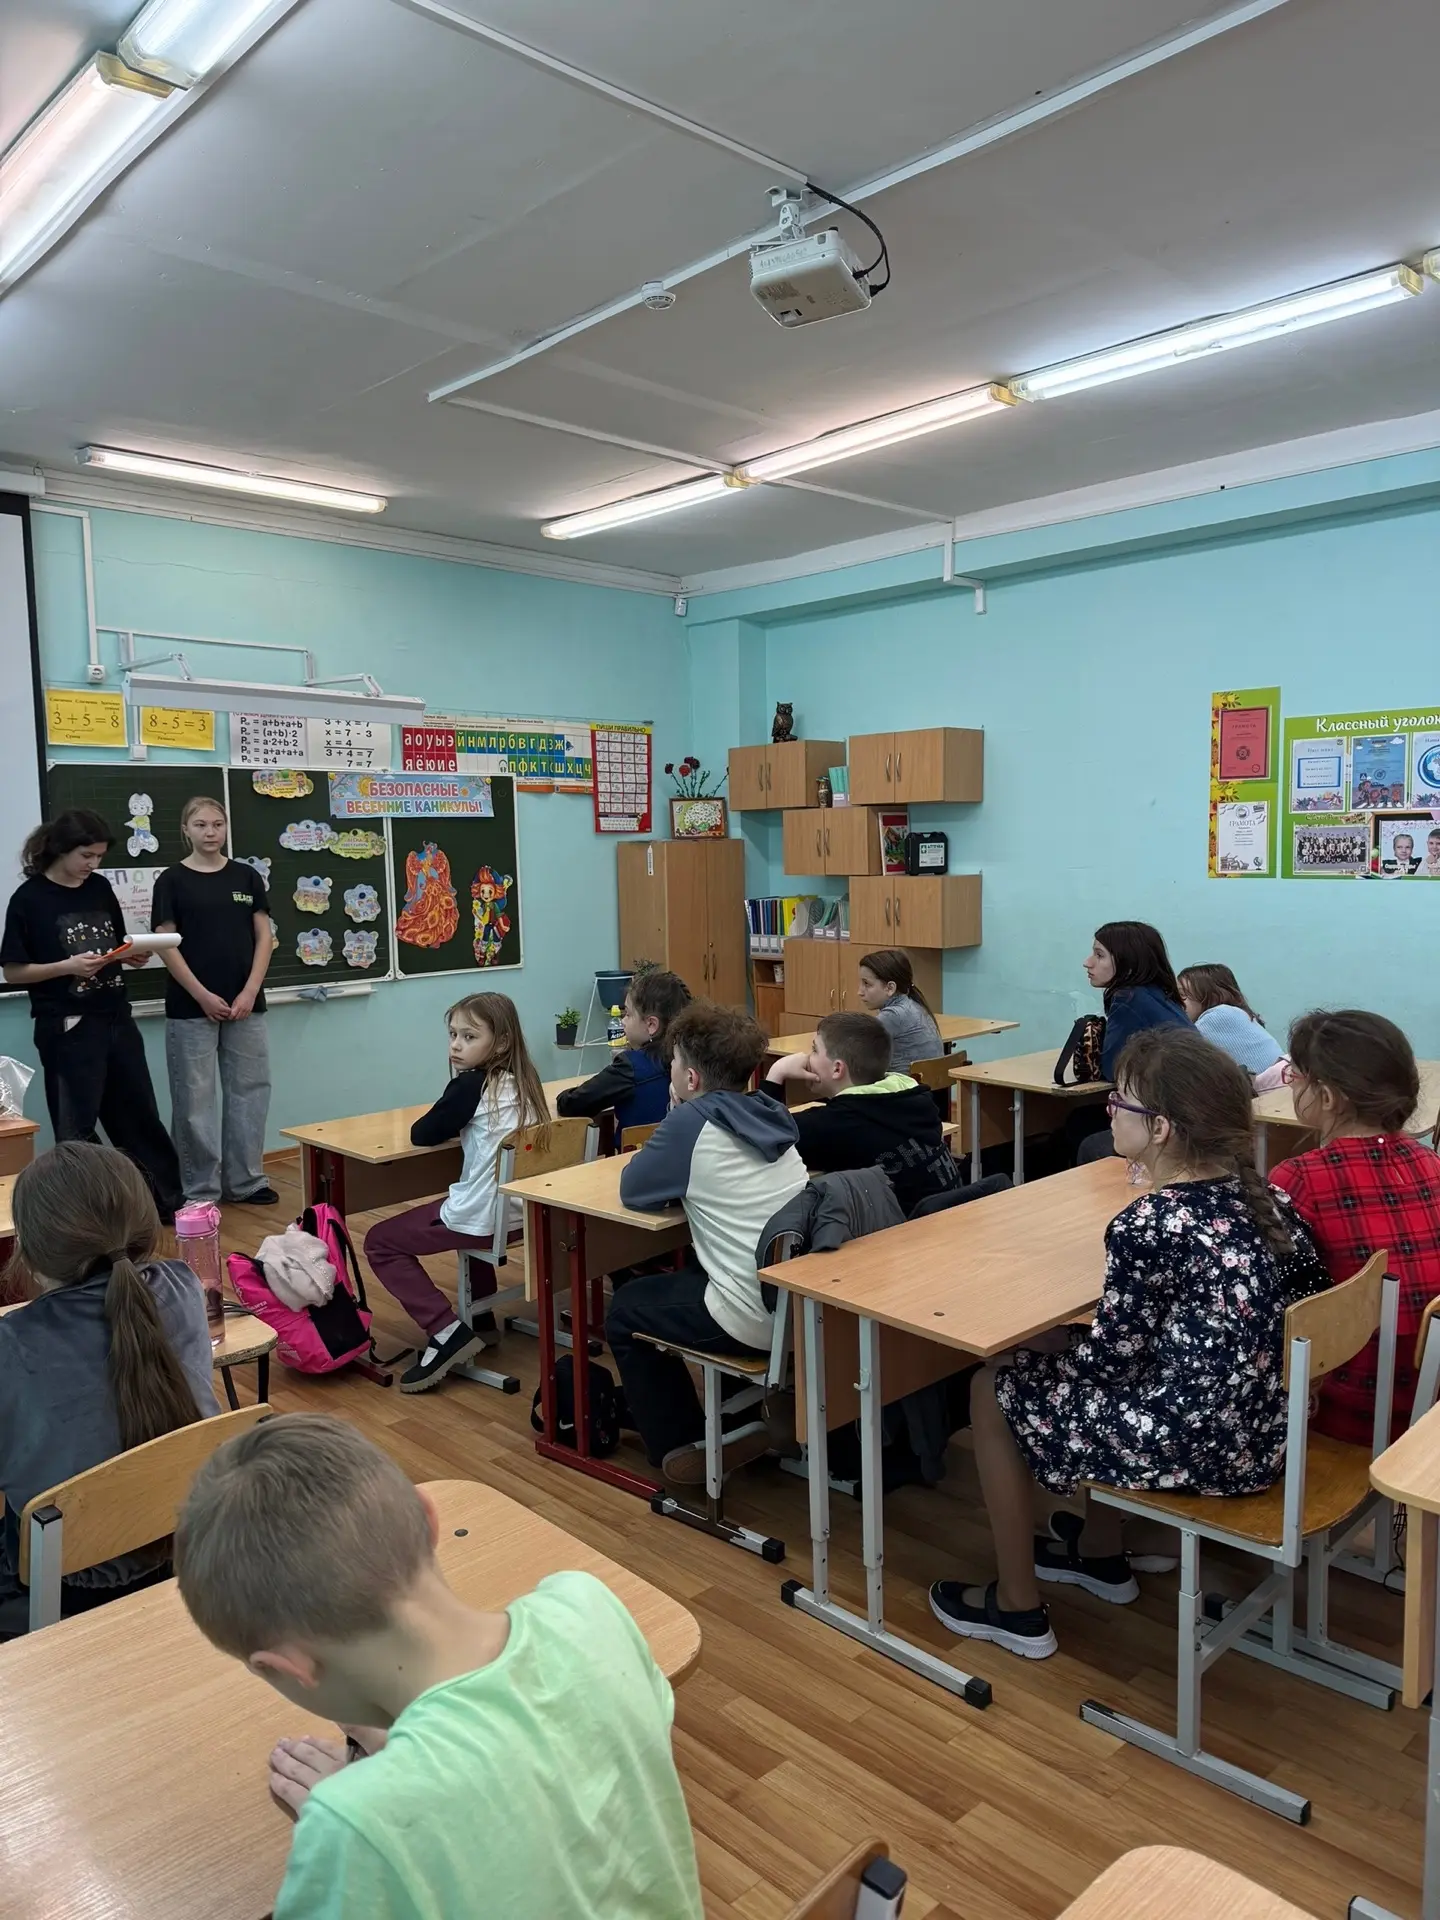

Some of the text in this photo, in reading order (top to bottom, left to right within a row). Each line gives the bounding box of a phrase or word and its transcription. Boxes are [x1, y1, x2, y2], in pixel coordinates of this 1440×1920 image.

[54, 711, 62, 725] 3
[66, 713, 78, 724] +
[83, 713, 91, 726] 5
[111, 714, 119, 728] 8
[150, 714, 158, 727] 8
[172, 716, 180, 729] 5
[198, 719, 206, 731] 3
[1316, 714, 1389, 732] Классный
[365, 730, 372, 738] 3
[345, 739, 352, 747] 4
[325, 748, 332, 757] 3
[366, 750, 372, 758] 7
[346, 759, 353, 767] 7
[366, 760, 372, 768] 7
[369, 781, 459, 797] БЕЗОПАСНЫЕ
[346, 800, 483, 814] ВЕСЕННИЕ КАНИКУЛЫ!
